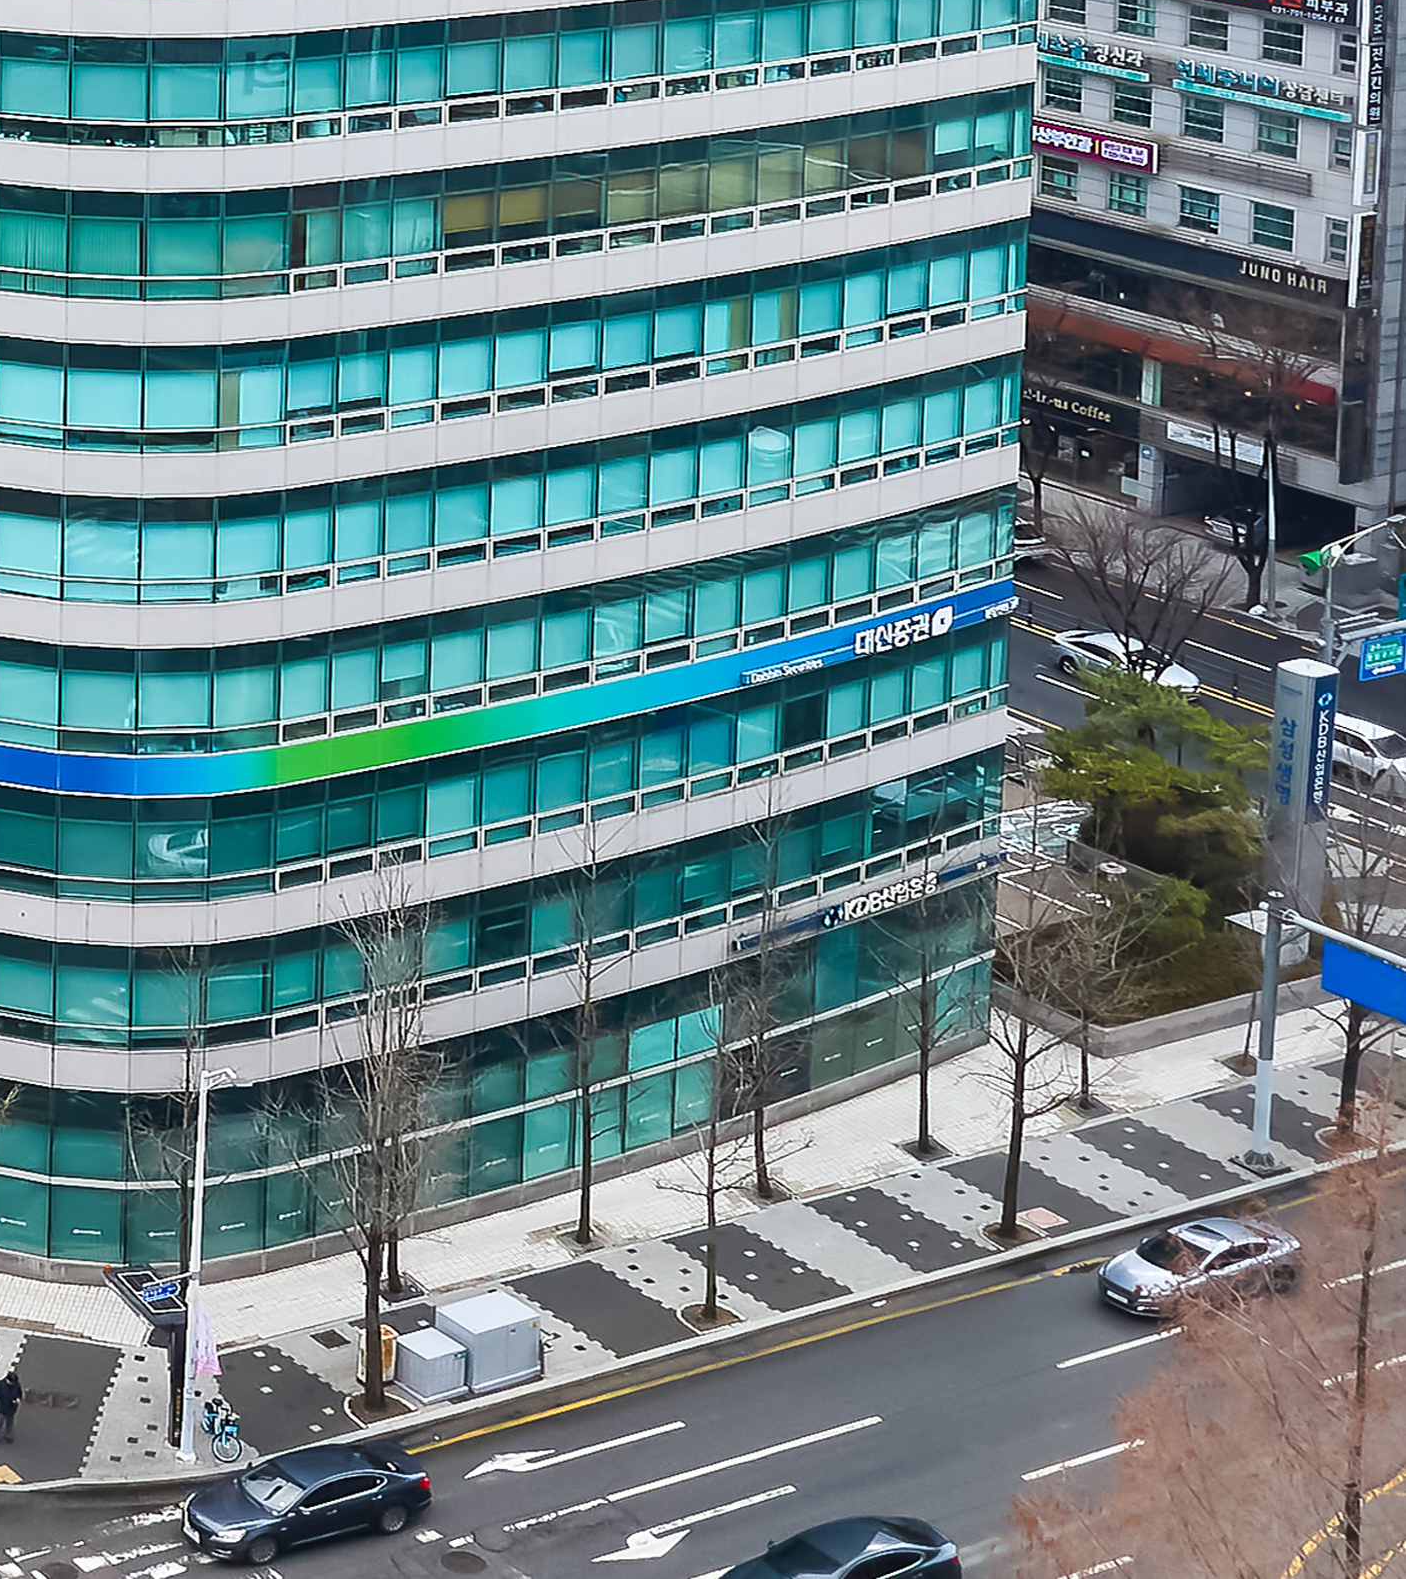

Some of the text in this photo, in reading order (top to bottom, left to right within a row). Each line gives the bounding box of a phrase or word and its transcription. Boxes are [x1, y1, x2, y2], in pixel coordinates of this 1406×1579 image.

[1092, 43, 1144, 67] 정신과
[1239, 260, 1328, 295] JUNO HAIR
[1071, 401, 1112, 423] Coffee
[854, 612, 930, 655] 대신증권
[1275, 717, 1298, 806] 삼성생명
[843, 872, 938, 921] KDB산업은행
